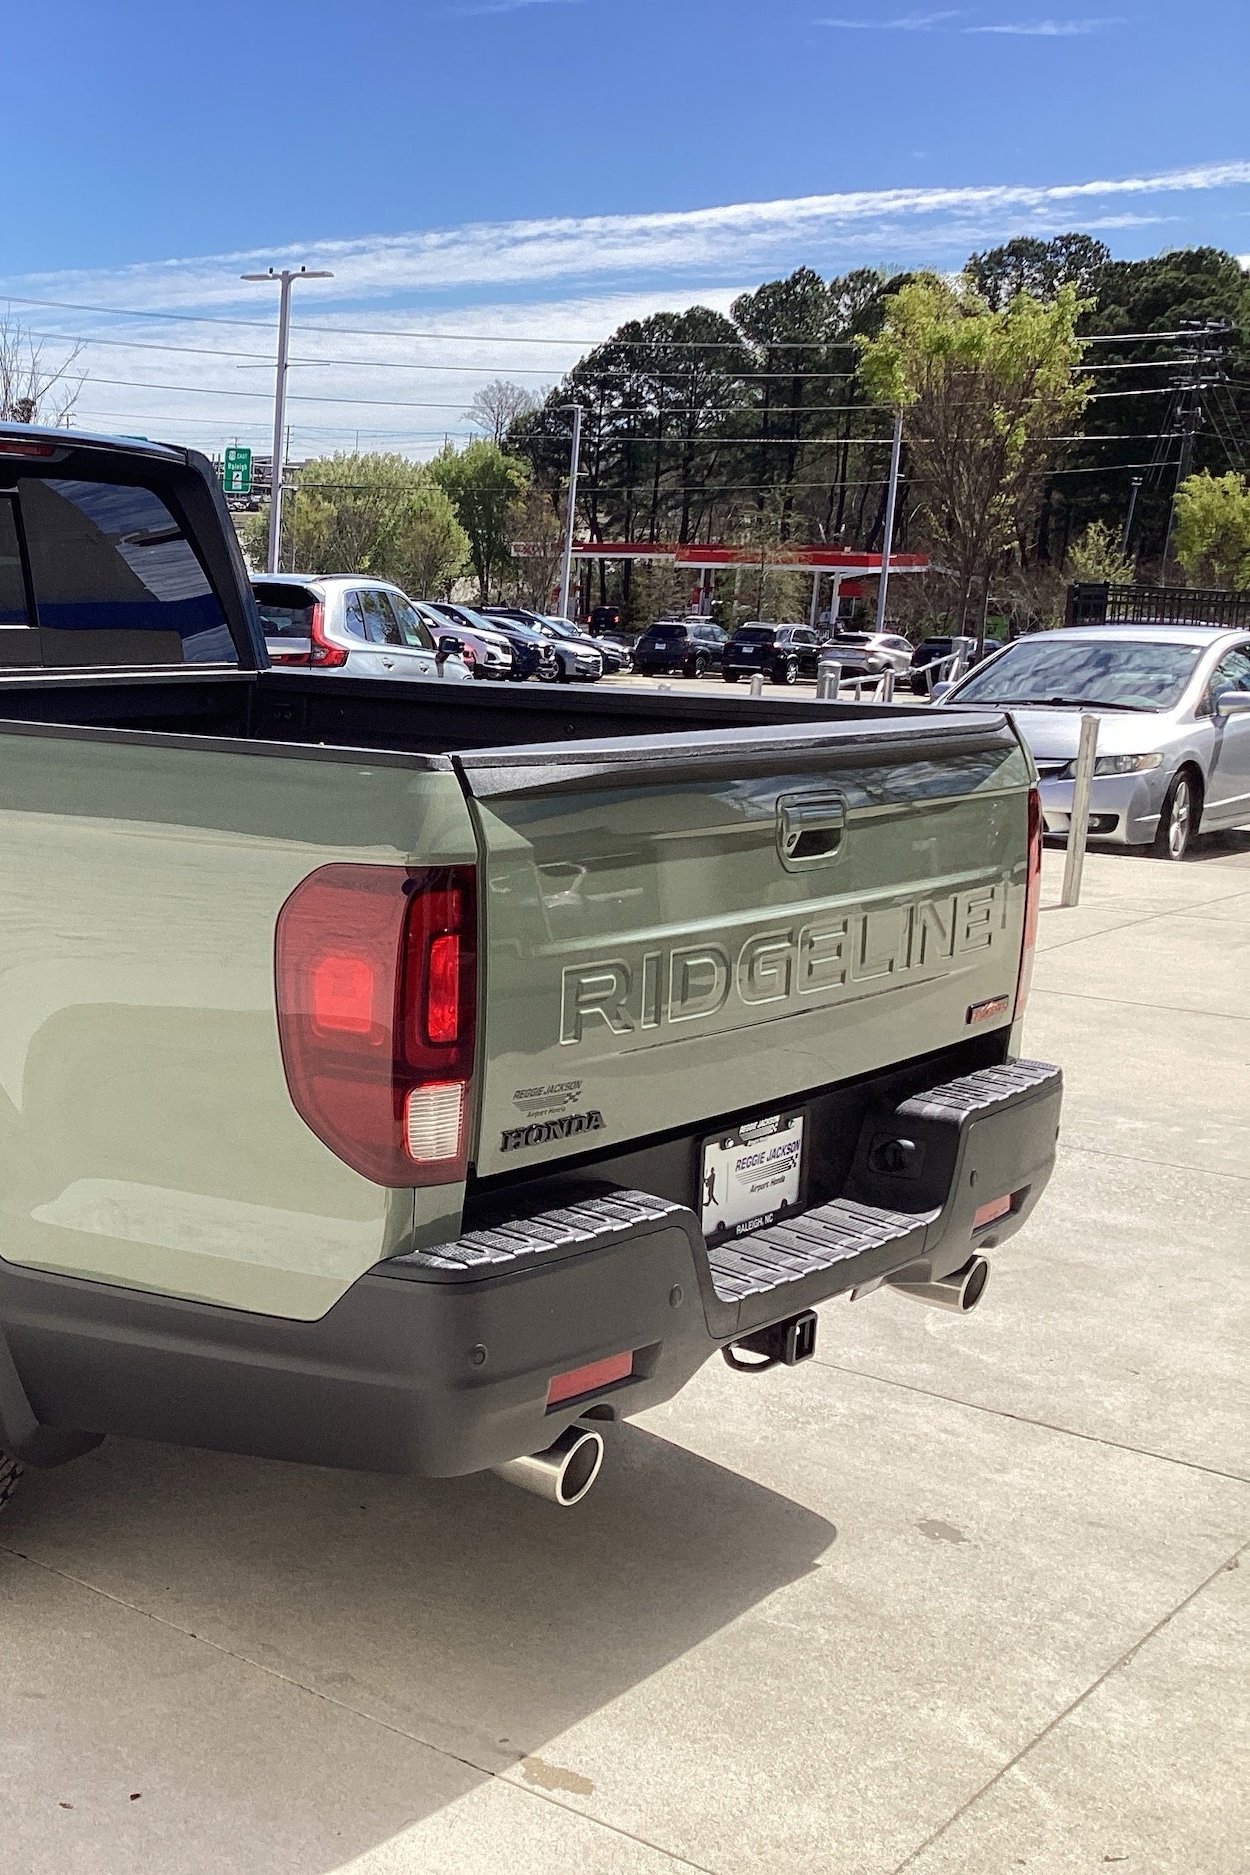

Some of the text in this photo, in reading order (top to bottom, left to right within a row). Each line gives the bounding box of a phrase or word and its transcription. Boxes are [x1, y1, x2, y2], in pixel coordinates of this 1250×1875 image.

[228, 462, 247, 471] Raleigh
[559, 885, 996, 1046] RIDGELINE
[513, 1080, 583, 1100] REGGIE JACKSON
[526, 1109, 548, 1118] Airport
[499, 1109, 607, 1152] HONDA
[735, 1139, 801, 1171] REGGIE JACKSON
[749, 1175, 786, 1193] Airport Honda
[764, 1213, 774, 1223] NC
